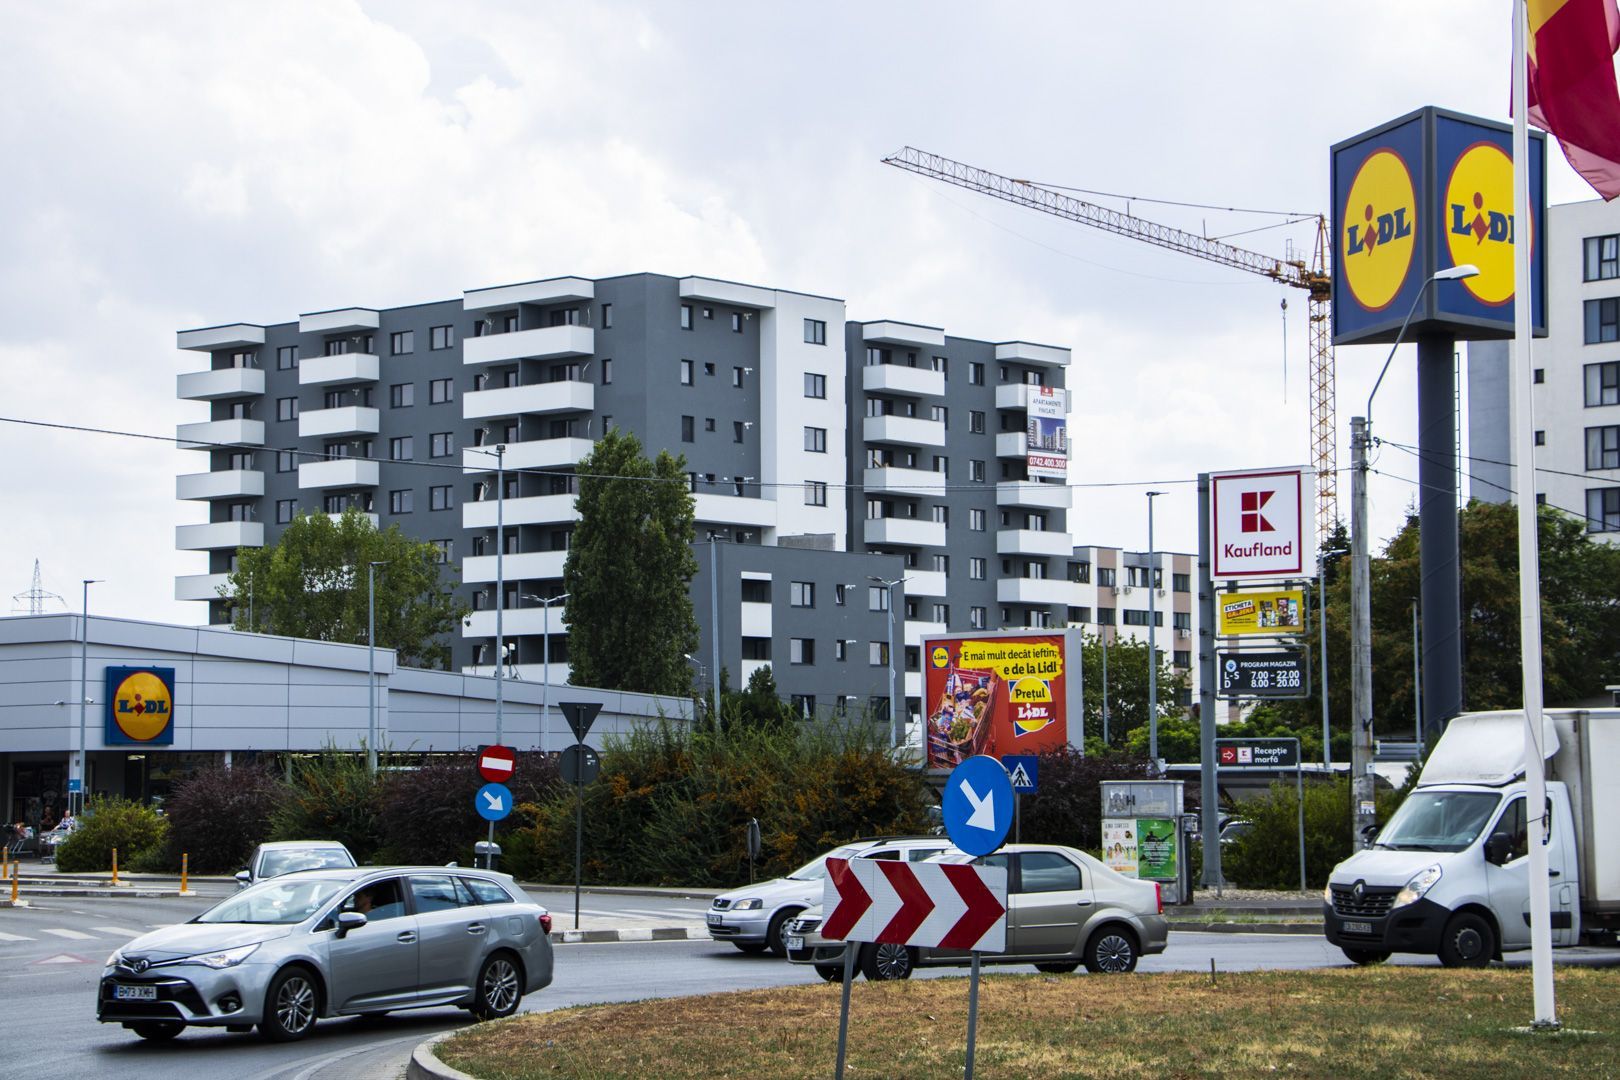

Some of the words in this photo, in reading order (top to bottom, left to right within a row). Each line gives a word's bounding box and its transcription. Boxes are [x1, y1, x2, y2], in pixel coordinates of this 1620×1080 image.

[1224, 541, 1292, 559] Kaufland
[1225, 601, 1252, 612] ETICHETA
[964, 651, 969, 661] E
[970, 651, 986, 661] mai
[987, 650, 1006, 660] mult
[1007, 648, 1031, 659] decât
[1032, 647, 1057, 658] ieftin,
[1003, 666, 1010, 675] e
[1012, 663, 1025, 675] de
[1026, 662, 1036, 674] la
[1038, 661, 1057, 673] Lidl
[1251, 671, 1269, 679] 7.00
[1276, 670, 1300, 679] 22.00
[1224, 680, 1231, 688] D
[1251, 679, 1269, 688] 8.00
[1276, 678, 1300, 688] 20.00
[1015, 687, 1046, 701] Prețul
[1254, 747, 1288, 756] Recepție
[1254, 755, 1279, 763] marfă
